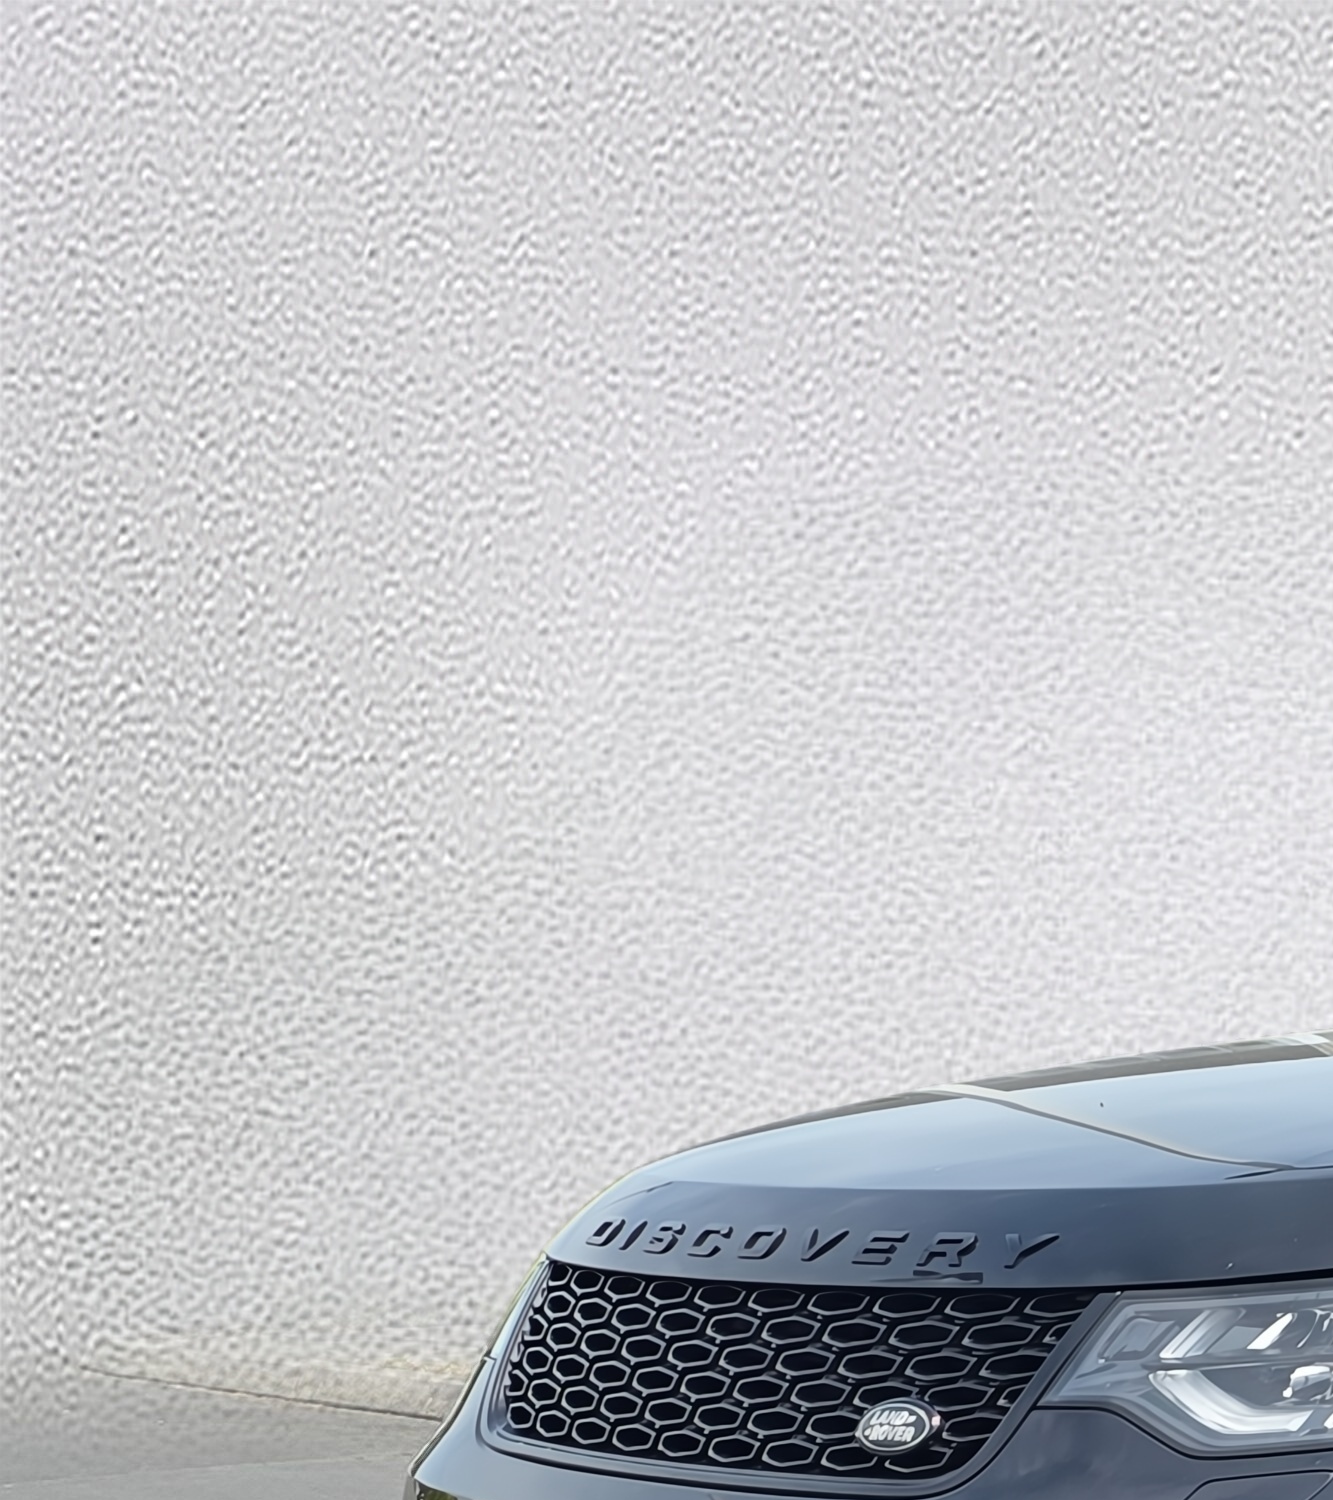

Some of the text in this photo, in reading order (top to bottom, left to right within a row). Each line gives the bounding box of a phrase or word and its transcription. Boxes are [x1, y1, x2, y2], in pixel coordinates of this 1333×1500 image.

[585, 1217, 1061, 1270] DISCOVERY
[869, 1410, 910, 1426] LAND
[868, 1424, 916, 1443] ROVER
